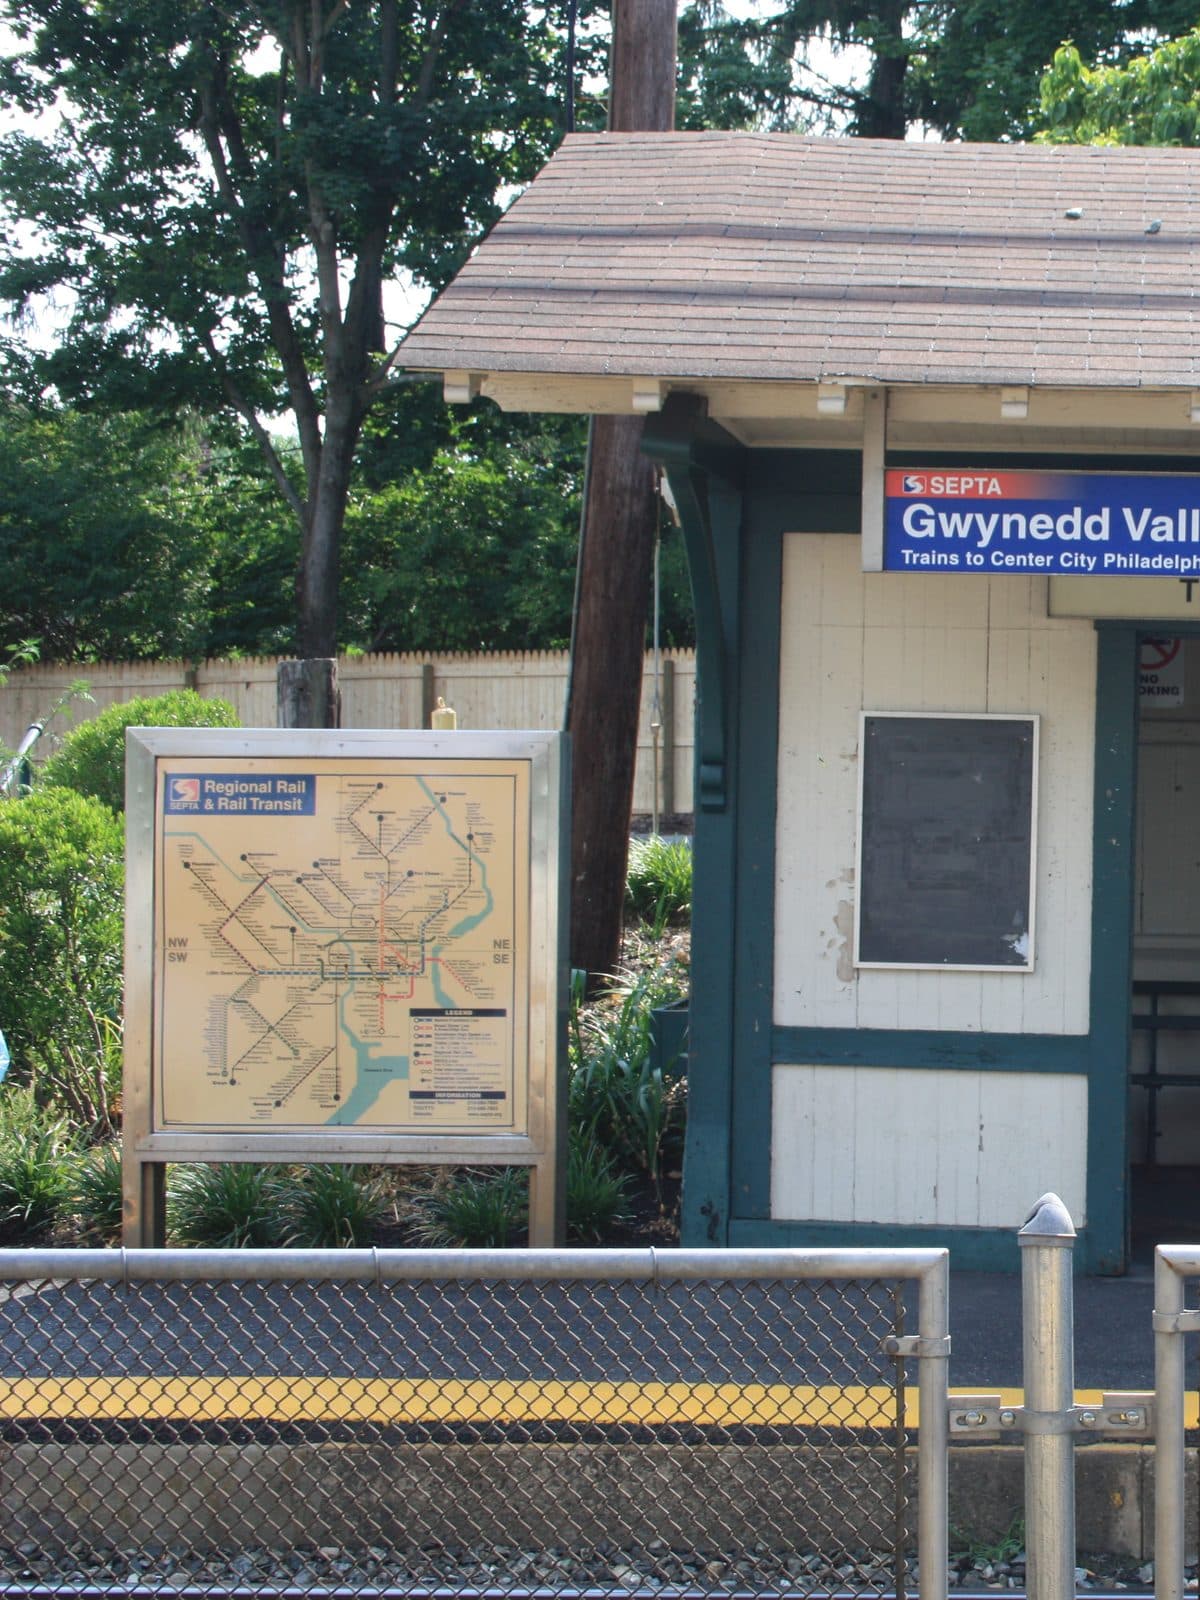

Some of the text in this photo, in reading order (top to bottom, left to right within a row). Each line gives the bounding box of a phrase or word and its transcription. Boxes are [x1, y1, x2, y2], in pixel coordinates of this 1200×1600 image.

[930, 476, 1002, 495] SEPTA
[902, 503, 1110, 548] Gwynedd
[901, 549, 959, 565] Trains
[966, 551, 985, 566] to
[991, 551, 1053, 567] Center
[1060, 552, 1097, 571] City
[1138, 686, 1180, 697] OKING
[204, 779, 307, 795] Regional Rail
[169, 802, 200, 811] SEPTA
[204, 797, 303, 811] & Rail Transit
[168, 937, 189, 948] NW
[493, 939, 510, 950] NE
[168, 952, 188, 962] SW
[493, 953, 510, 965] SE
